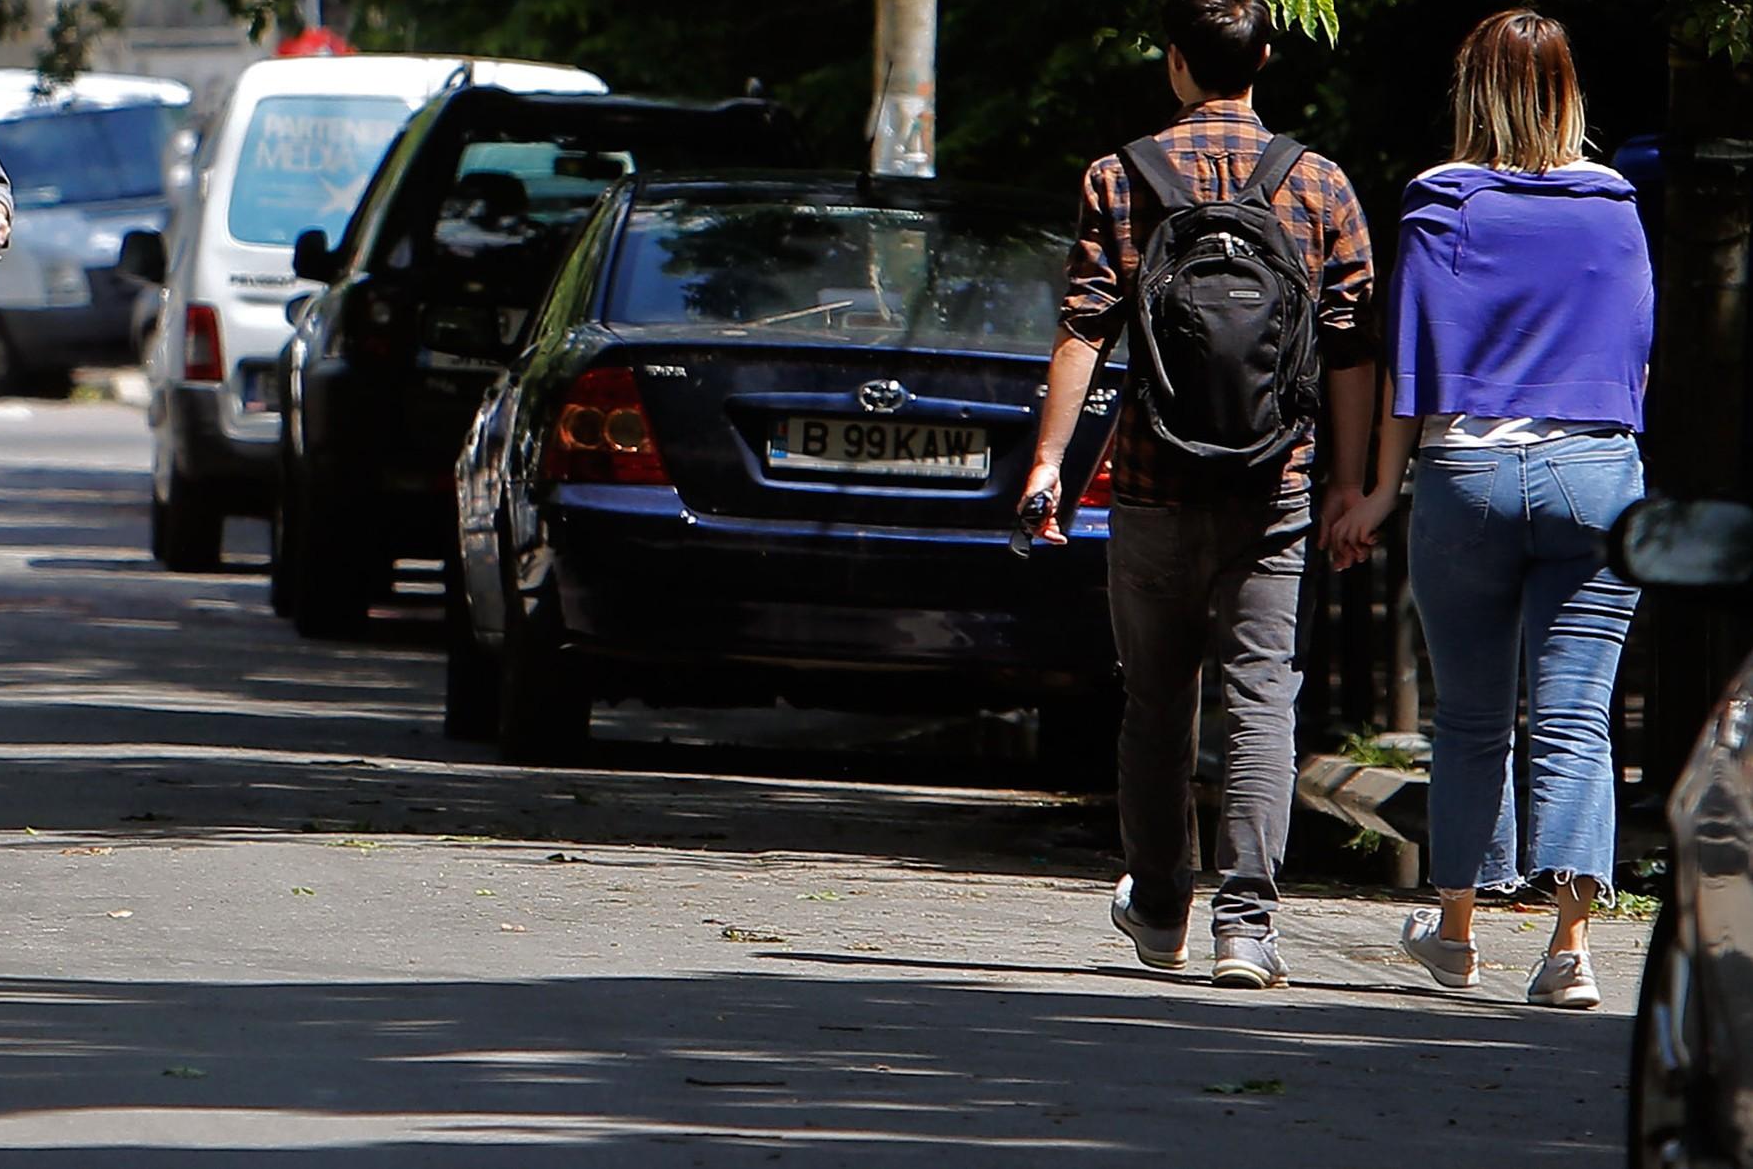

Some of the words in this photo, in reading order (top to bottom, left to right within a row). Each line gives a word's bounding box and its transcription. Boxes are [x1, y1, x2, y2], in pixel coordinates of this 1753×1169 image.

[802, 421, 828, 457] B
[844, 423, 886, 460] 99
[894, 427, 973, 466] KAW
